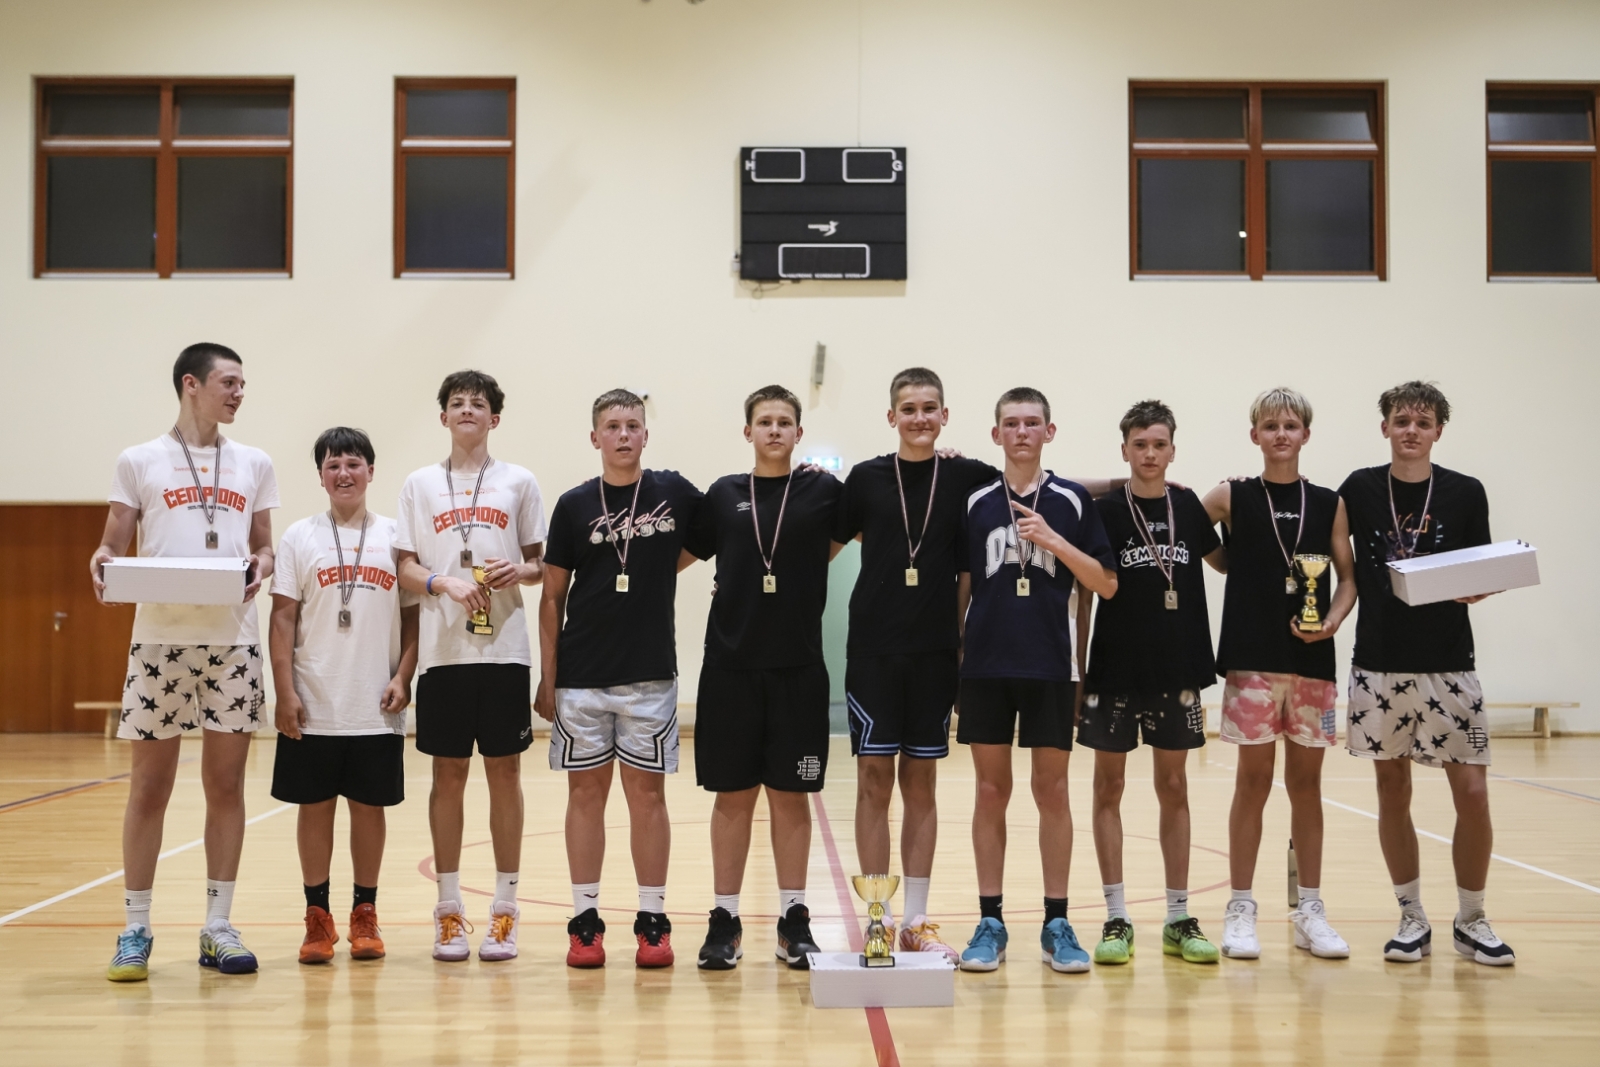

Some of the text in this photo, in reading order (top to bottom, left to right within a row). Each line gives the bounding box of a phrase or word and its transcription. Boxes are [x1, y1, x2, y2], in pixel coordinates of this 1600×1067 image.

[745, 160, 755, 171] H
[892, 160, 903, 171] G
[1119, 544, 1189, 568] ČEMIONS
